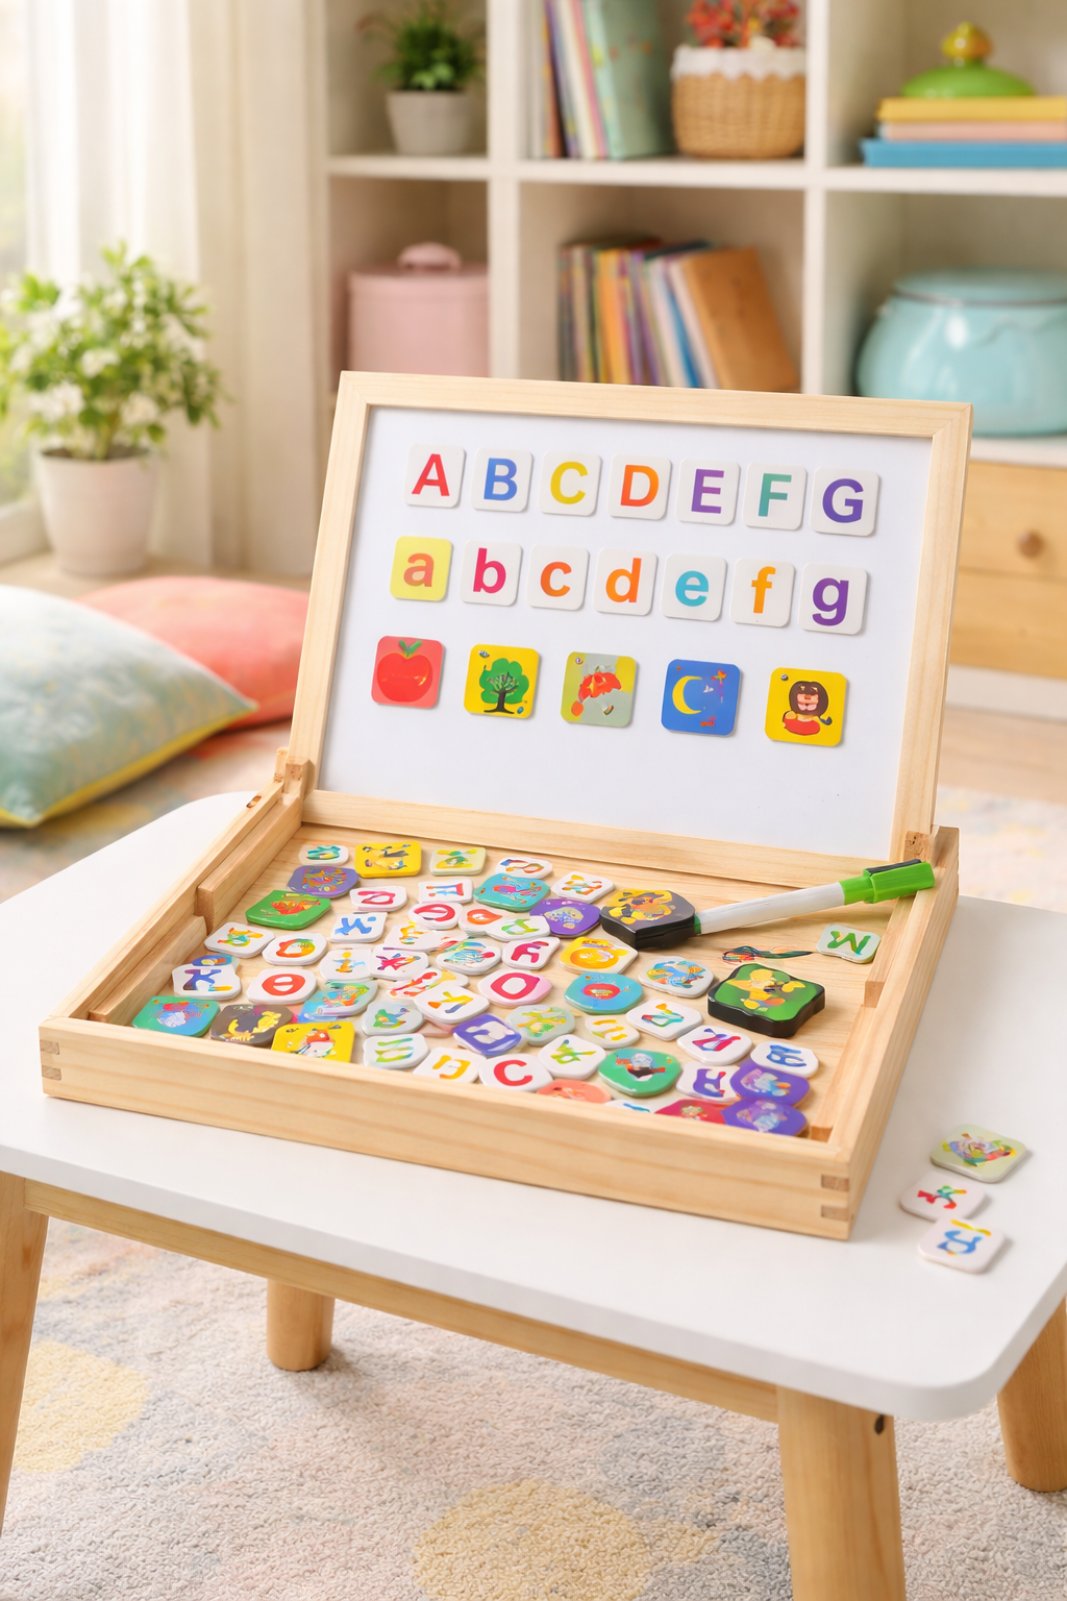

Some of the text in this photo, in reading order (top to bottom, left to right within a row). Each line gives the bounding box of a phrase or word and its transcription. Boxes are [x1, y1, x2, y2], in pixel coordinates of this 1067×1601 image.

[412, 454, 862, 522] A B C D E F G
[403, 547, 848, 625] a b c d e f g
